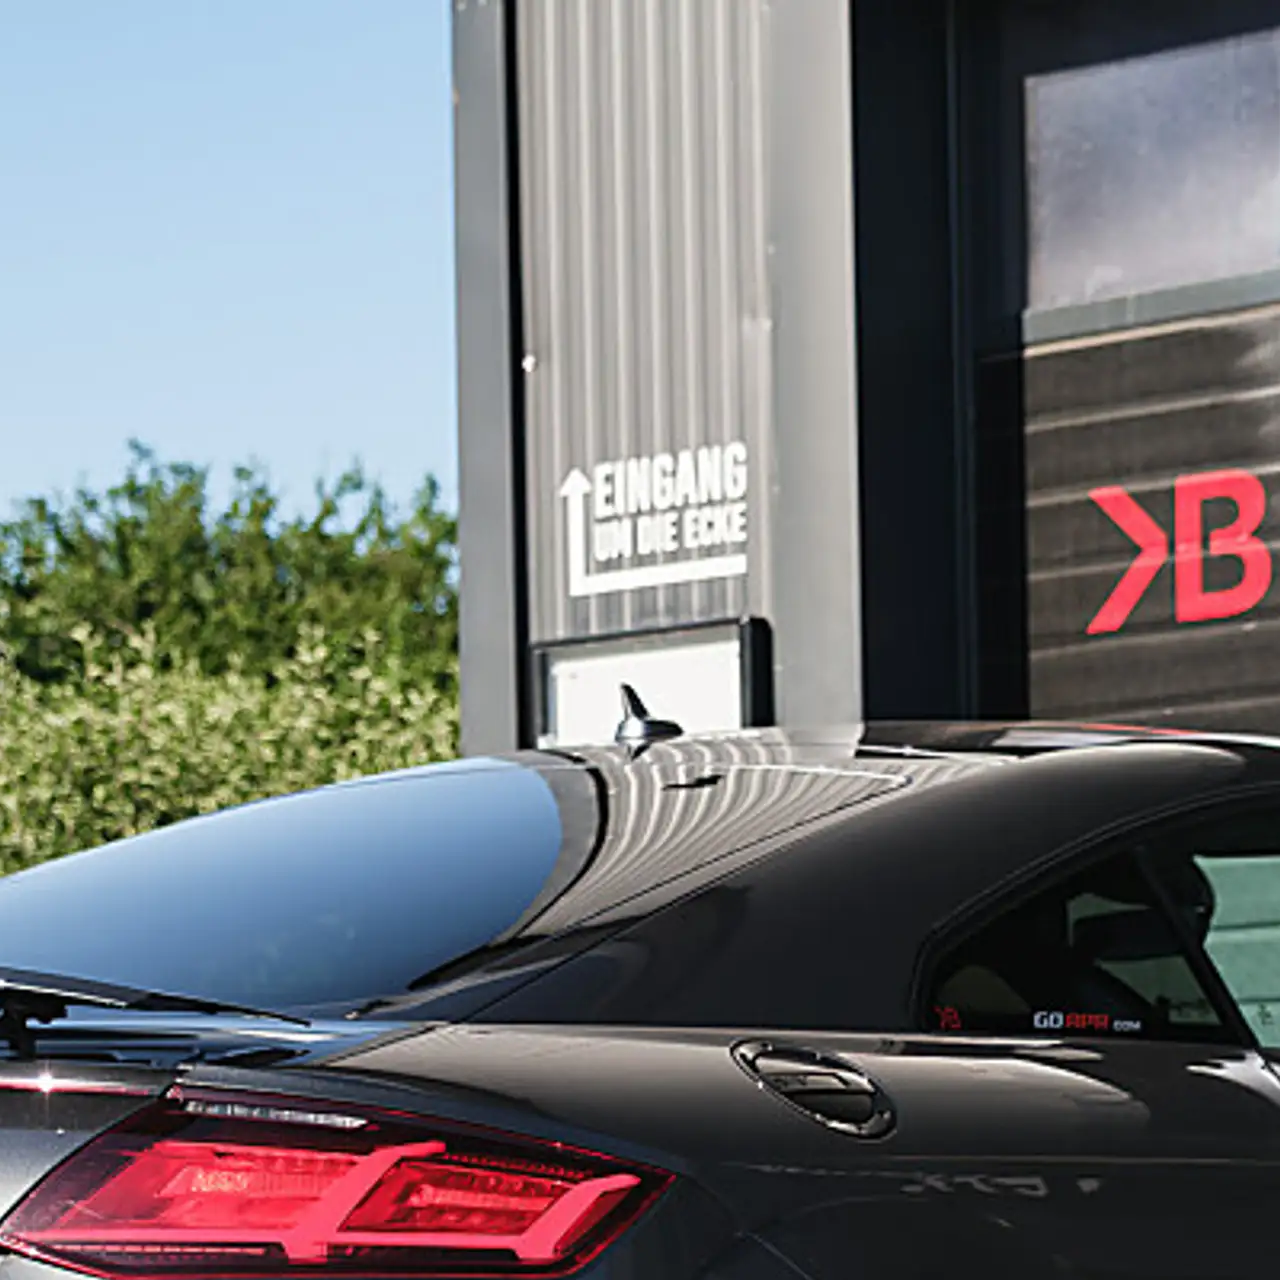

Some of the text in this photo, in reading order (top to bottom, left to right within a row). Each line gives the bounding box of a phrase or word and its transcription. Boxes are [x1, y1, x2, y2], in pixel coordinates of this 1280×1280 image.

[593, 441, 747, 519] EINGANG
[636, 511, 678, 555] DIE
[683, 502, 747, 549] ECKE
